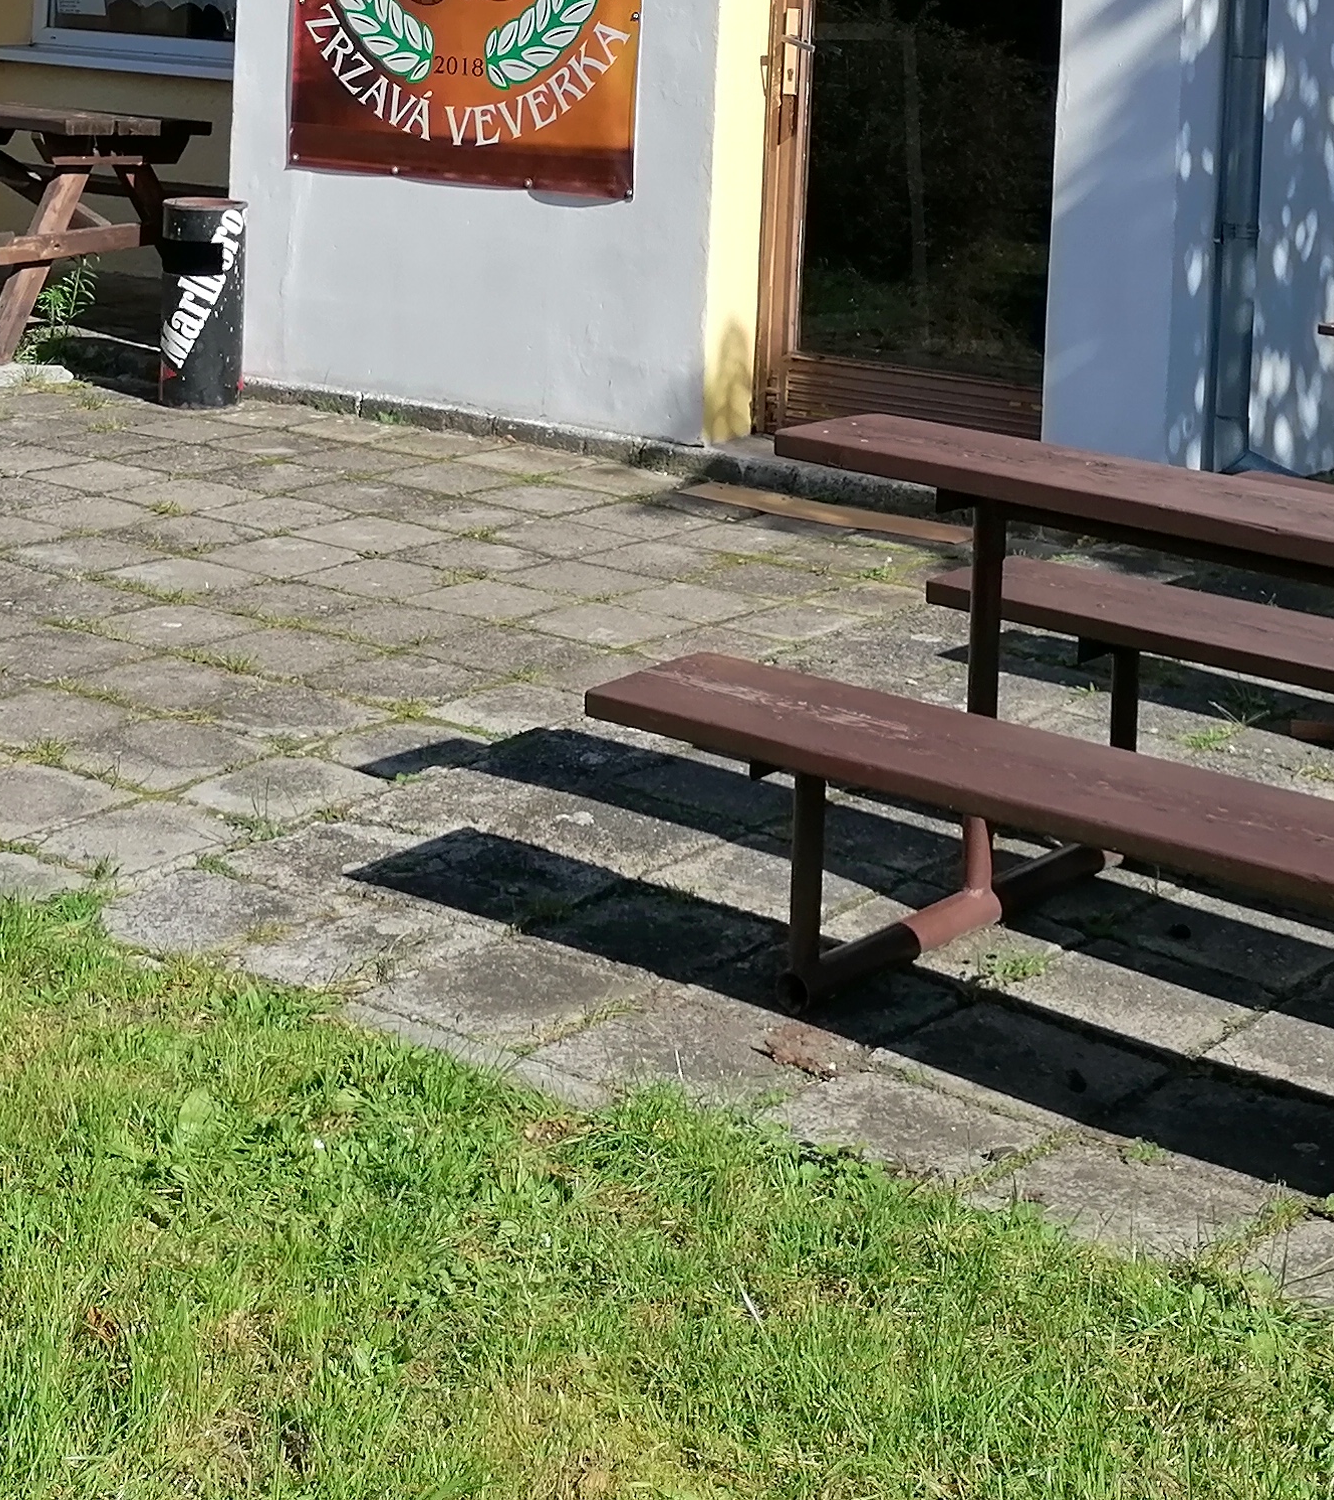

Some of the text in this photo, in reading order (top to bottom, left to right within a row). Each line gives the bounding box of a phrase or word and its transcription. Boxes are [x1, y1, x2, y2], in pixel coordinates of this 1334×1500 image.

[304, 2, 632, 148] ZRZAVÁ VEVERKA
[433, 55, 485, 78] 2018
